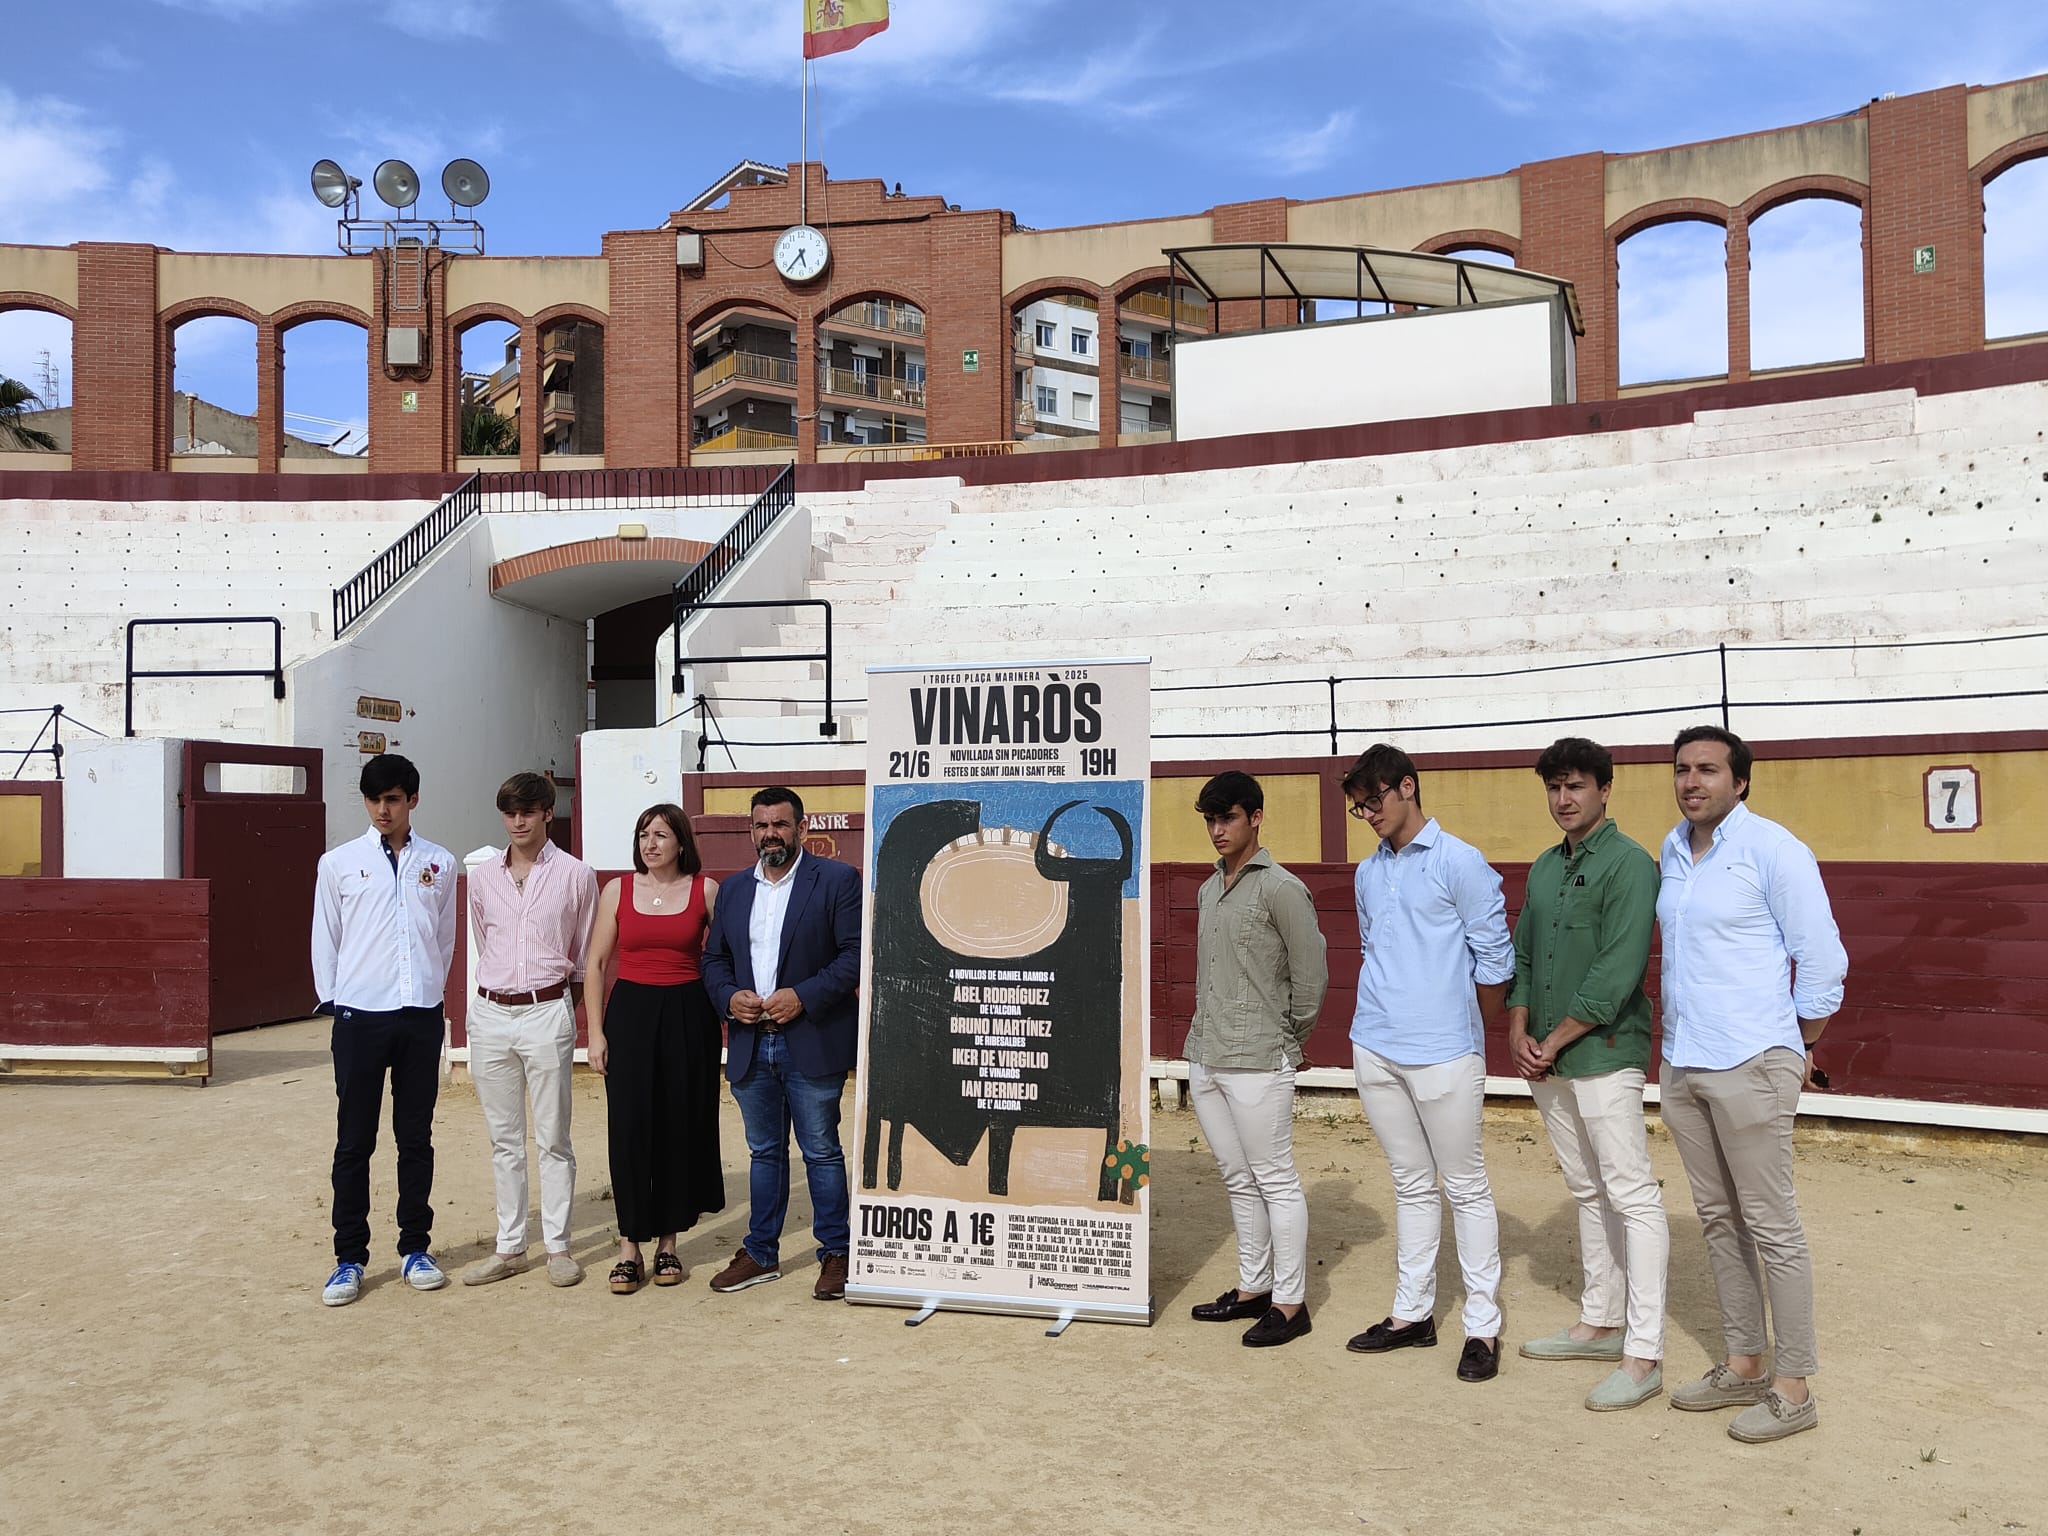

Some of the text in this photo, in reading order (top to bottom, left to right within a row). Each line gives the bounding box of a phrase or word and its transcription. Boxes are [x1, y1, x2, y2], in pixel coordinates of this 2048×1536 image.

[930, 674, 961, 684] TROFEO
[964, 673, 991, 683] PLAÇA
[995, 671, 1040, 682] MARINERA
[1065, 670, 1088, 680] 2025
[910, 673, 1102, 745] VINARÒS
[950, 748, 1059, 761] NOVILLADA SIN PICADORES
[1080, 748, 1117, 776] 19H
[889, 750, 930, 778] 21/6
[944, 766, 969, 778] FESTES
[970, 766, 980, 777] DE
[980, 766, 1000, 777] SANT
[1001, 766, 1020, 776] JOAN
[1026, 765, 1046, 776] SANT
[1047, 765, 1066, 776] PERE
[1942, 781, 1960, 823] 7
[811, 840, 825, 856] 12
[949, 969, 1055, 982] 4 NOVILLOS DE DANIEL RAMOS 4
[954, 985, 1049, 1005] ABEL RODRÍGUEZ
[980, 1005, 988, 1014] DE
[950, 1017, 1052, 1037] BRUNO MARTÍNEZ
[975, 1036, 983, 1045] DE
[952, 1048, 1048, 1069] IKER DE VIRGILIO
[979, 1067, 988, 1077] DE
[962, 1080, 1038, 1100] IAN BERMEJO
[977, 1099, 987, 1109] DE
[860, 1204, 995, 1246] TOROS A 1€
[1008, 1214, 1025, 1222] VENTA
[1027, 1215, 1059, 1225] ANTICIPADA
[1077, 1219, 1088, 1227] BAR
[1090, 1220, 1096, 1228] DE
[1106, 1221, 1123, 1230] PLAZA
[1125, 1223, 1132, 1231] DE
[1008, 1224, 1026, 1232] TOROS
[1038, 1226, 1061, 1234] VINARÒS
[1064, 1227, 1080, 1235] DESDE
[1092, 1230, 1114, 1238] MARTES
[1116, 1231, 1122, 1239] 10
[1125, 1232, 1132, 1240] DE
[1008, 1233, 1023, 1241] JUNIO
[1026, 1234, 1033, 1242] DE
[858, 1239, 873, 1248] NIÑOS
[885, 1241, 903, 1250] GRATIS
[980, 1248, 994, 1256] AÑOS
[1008, 1242, 1024, 1250] VENTA
[1035, 1244, 1059, 1253] TAQUILLA
[1070, 1246, 1076, 1254] LA
[1078, 1247, 1095, 1256] PLAZA
[1097, 1248, 1104, 1256] DE
[1106, 1249, 1124, 1258] TOROS
[857, 1249, 896, 1258] ACOMPAÑADOS
[928, 1254, 947, 1262] ADULTO
[970, 1257, 994, 1266] ENTRADA
[1008, 1250, 1016, 1258] DÍA
[1029, 1252, 1049, 1261] FESTEJO
[1051, 1254, 1057, 1262] DE
[1078, 1256, 1098, 1265] HORAS
[1103, 1258, 1120, 1267] DESDE
[1122, 1260, 1131, 1268] LAS
[1017, 1261, 1035, 1269] HORAS
[1040, 1263, 1057, 1271] HASTA
[1072, 1266, 1089, 1274] INICIO
[1094, 1267, 1103, 1275] DEL
